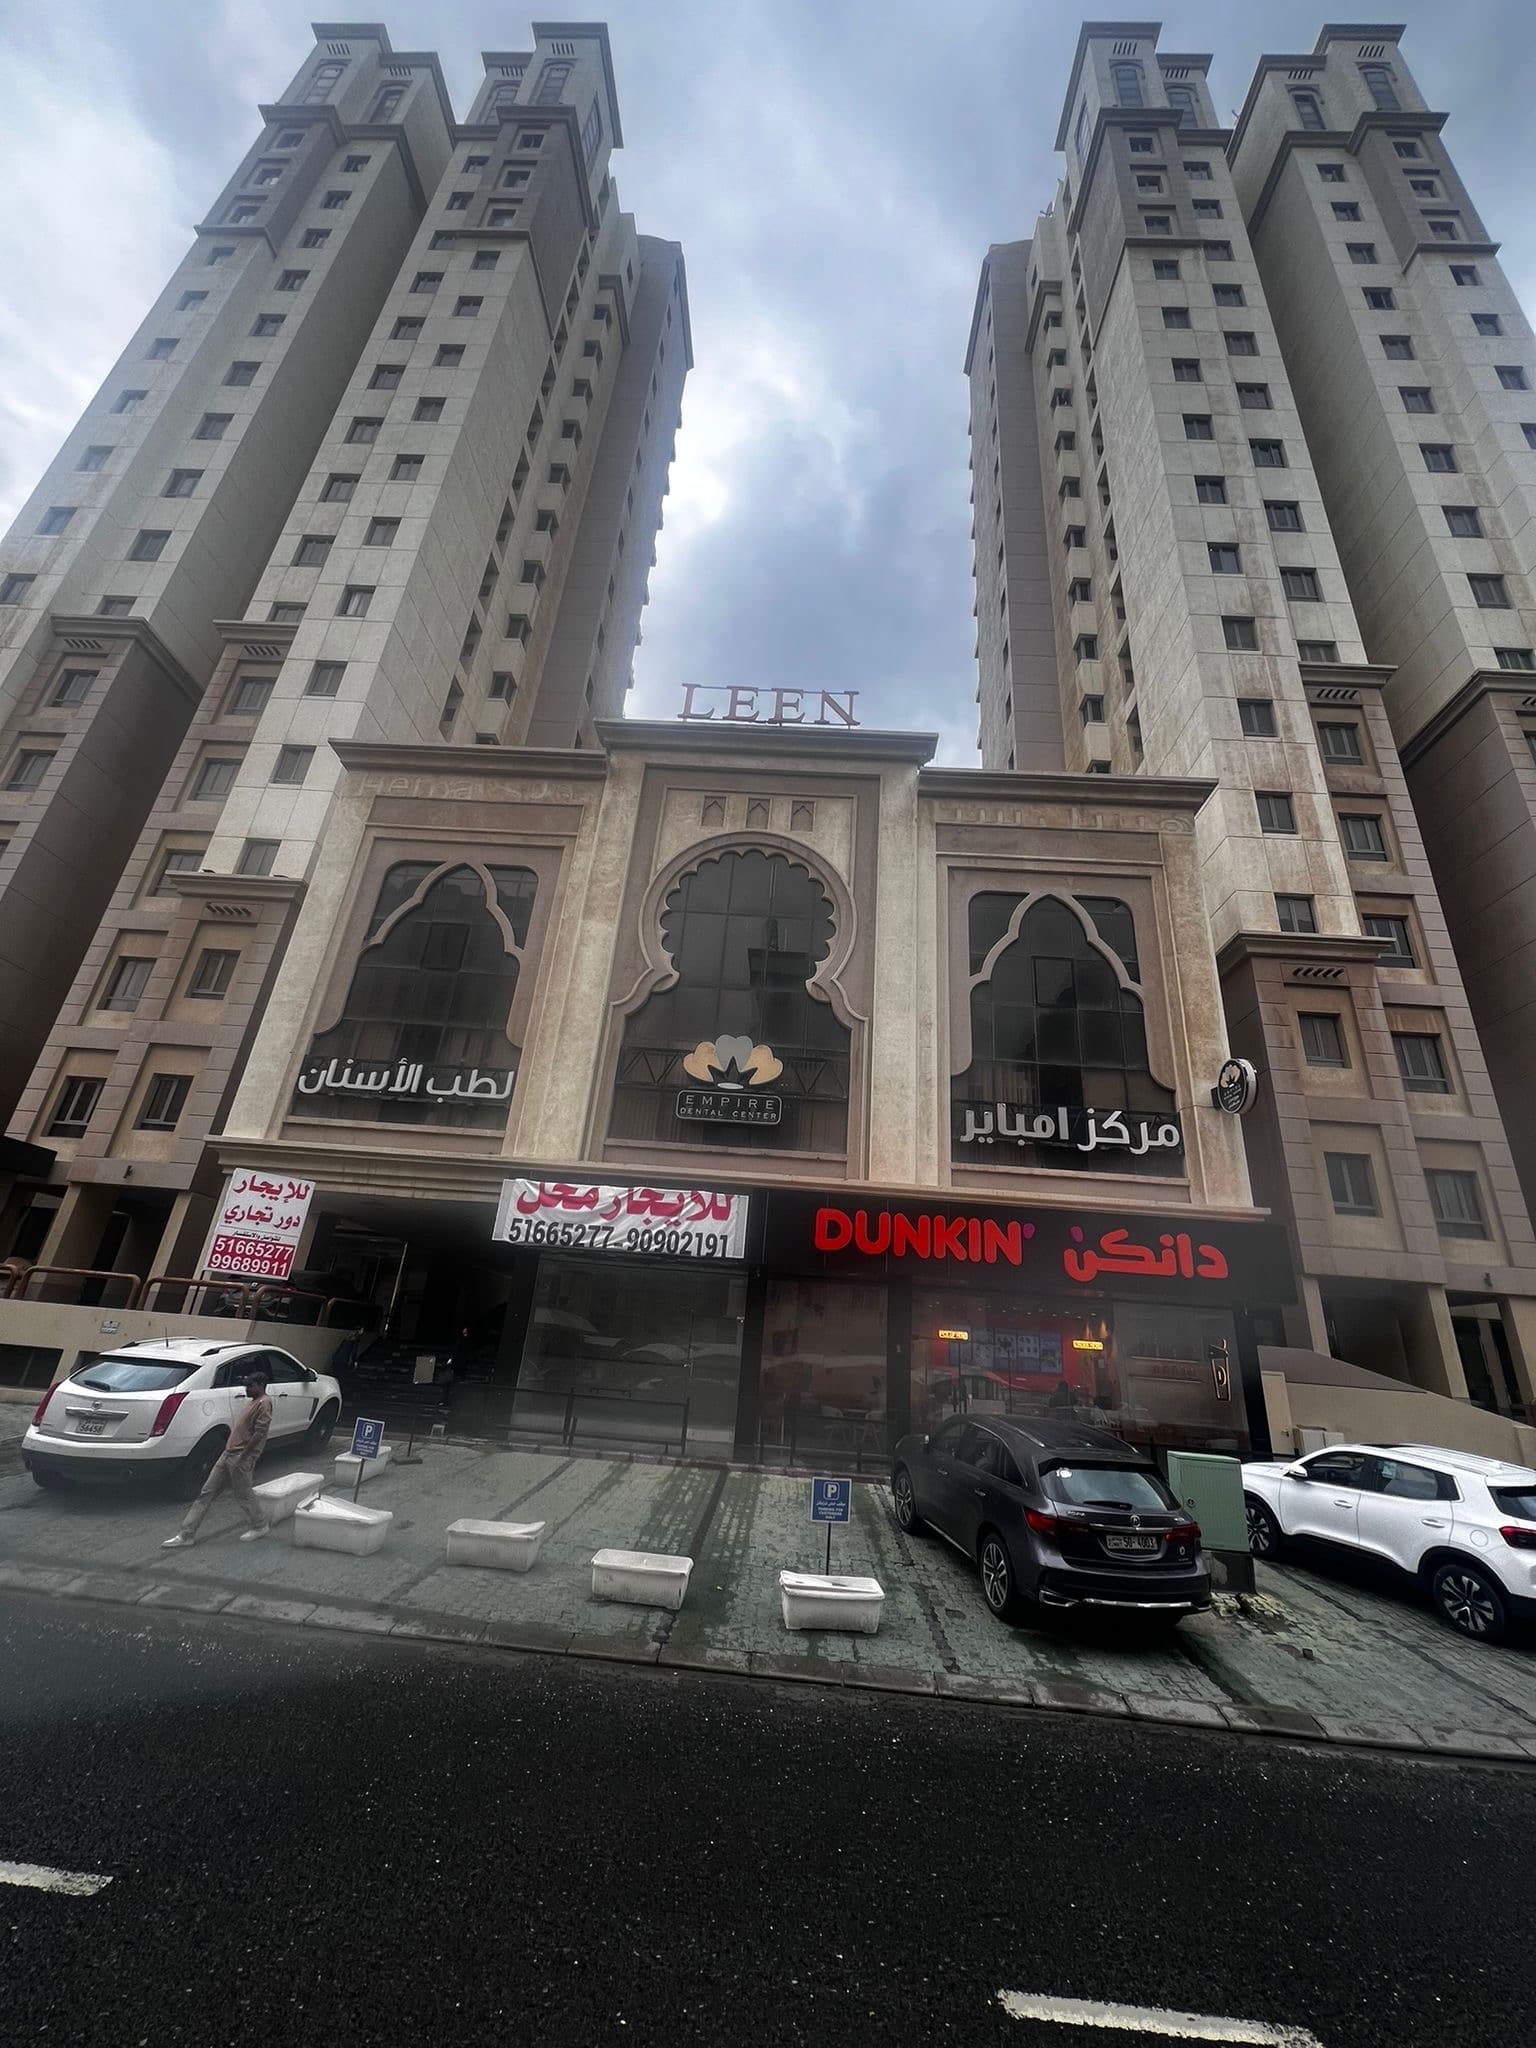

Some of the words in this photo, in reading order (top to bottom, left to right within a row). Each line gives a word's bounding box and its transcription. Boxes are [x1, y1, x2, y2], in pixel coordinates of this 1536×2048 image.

[677, 683, 861, 726] LEEN
[298, 1057, 424, 1094] الأسنان
[426, 1069, 515, 1103] لطب
[680, 1107, 723, 1117] DENTAL
[732, 1110, 777, 1120] CENTER
[686, 1095, 775, 1109] EMPIRE
[959, 1103, 1070, 1146] امباير
[1077, 1108, 1181, 1155] مركز
[233, 1174, 311, 1203] للإيجار
[516, 1181, 600, 1215] محل
[224, 1205, 274, 1225] تجاري
[273, 1215, 301, 1230] دور
[215, 1238, 294, 1260] 51665277
[815, 1208, 1036, 1266] DUNKIN'
[210, 1254, 288, 1276] 99689911
[1063, 1225, 1229, 1282] دانكن
[828, 1484, 837, 1497] P
